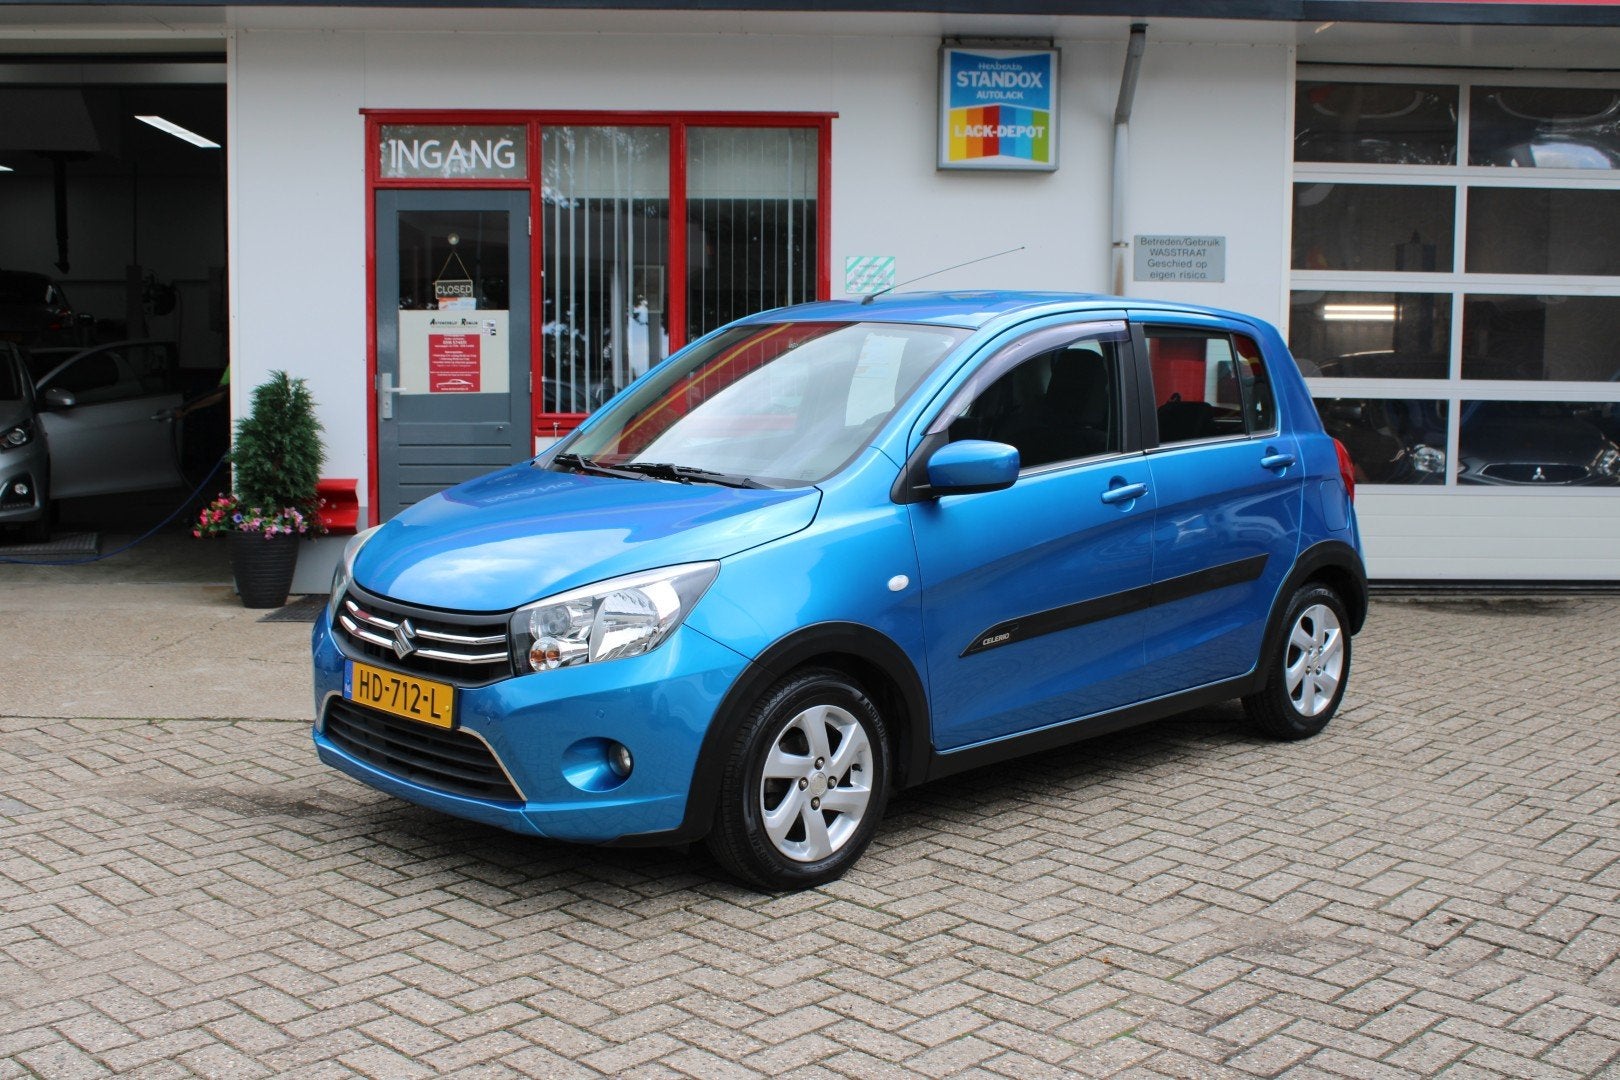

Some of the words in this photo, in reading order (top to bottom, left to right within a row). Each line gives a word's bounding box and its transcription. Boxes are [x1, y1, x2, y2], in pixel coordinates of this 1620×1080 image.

[956, 71, 1043, 88] STANDOX
[976, 90, 1024, 100] AUTOLACK
[954, 124, 1045, 139] LACK-DEPOT
[388, 139, 515, 170] INGANG
[1140, 237, 1220, 247] Betreden/Gebruik
[1149, 248, 1207, 257] WASSTRAAT
[1147, 259, 1192, 268] Geschied
[1195, 261, 1208, 269] op
[1149, 271, 1176, 280] eigen
[436, 285, 472, 294] CLOSED
[982, 632, 1010, 646] CELERIO
[359, 669, 441, 719] HD-712-L
